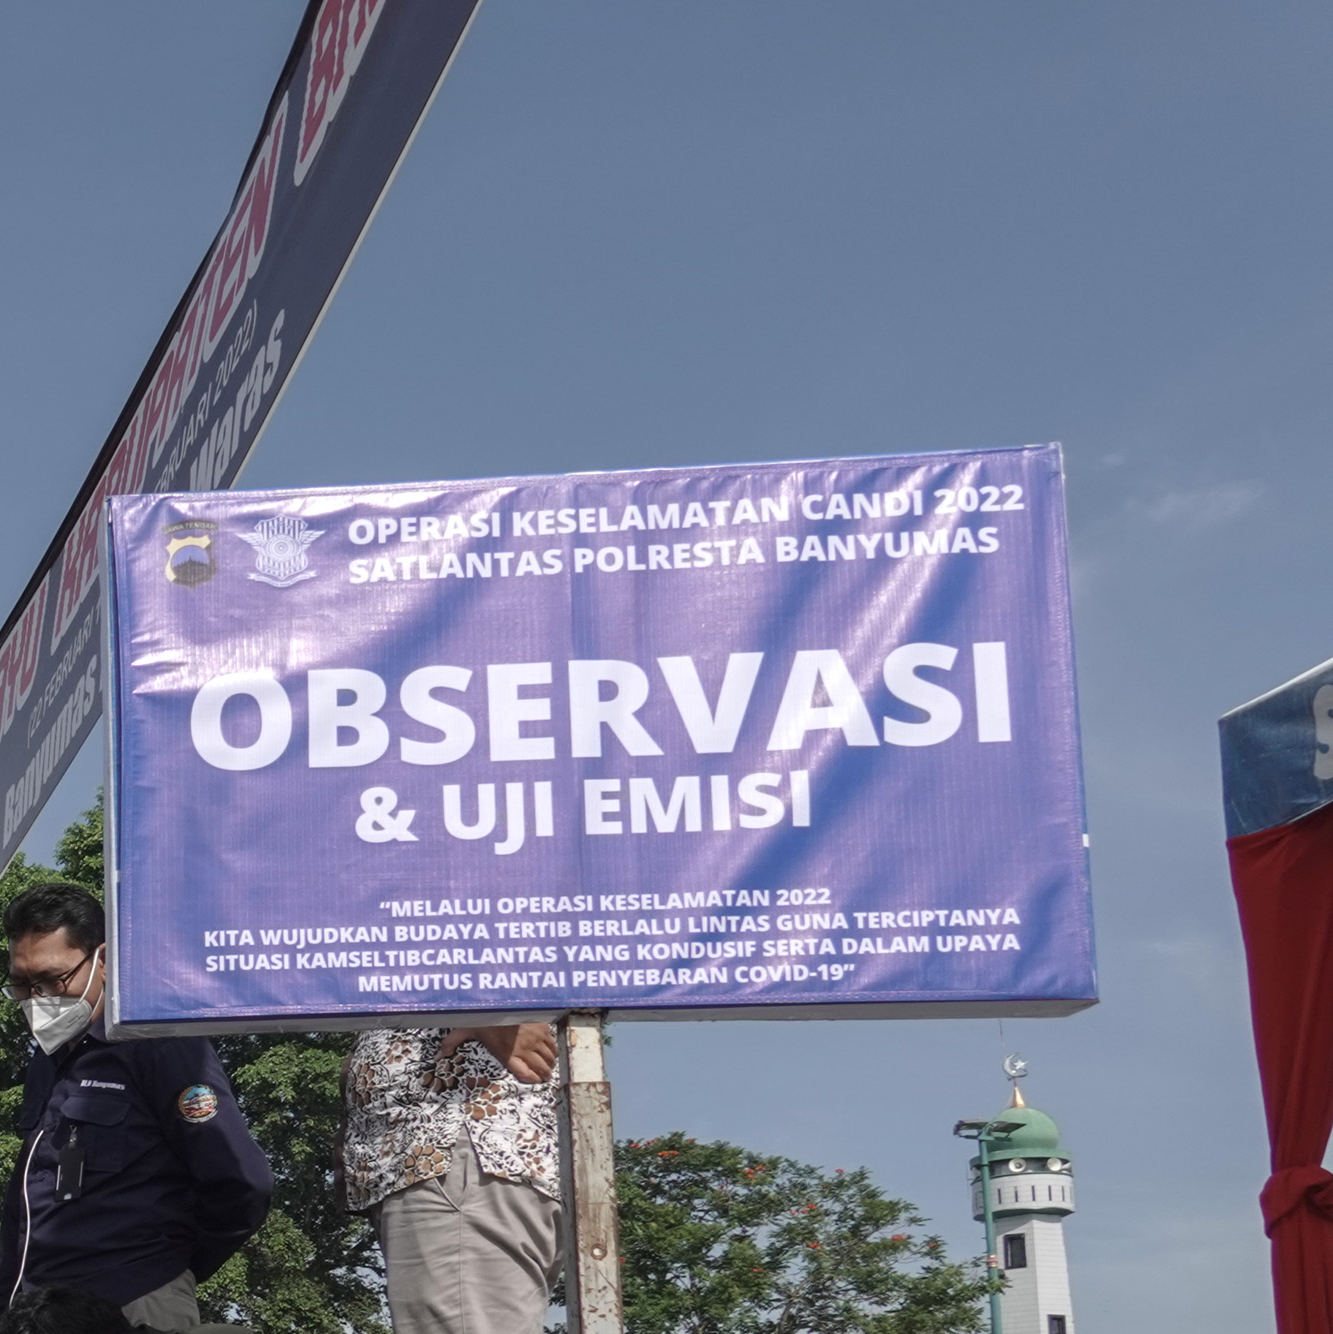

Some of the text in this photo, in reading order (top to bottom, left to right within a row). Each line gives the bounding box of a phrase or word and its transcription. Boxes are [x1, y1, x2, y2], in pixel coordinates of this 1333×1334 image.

[348, 484, 1025, 545] OPERASI KESELAMATAN CANDI 2022
[349, 549, 563, 585] SATLANTAS
[573, 538, 766, 574] POLRESTA
[776, 526, 1000, 563] BANYUMAS
[42, 614, 93, 709] FEBRUARI
[190, 640, 1012, 771] OBSERVASI
[2, 653, 98, 850] Banyumas
[353, 769, 811, 856] & UJI EMISI
[204, 907, 1021, 950] KITA WUJUDKAN BUDAYA TERTIB BERLALU LINTAS GUNA TERCIPTANYA
[497, 895, 593, 915] OPERASI
[600, 889, 770, 912] KESELAMATAN
[776, 887, 832, 906] 2022
[205, 932, 1021, 972] SITUASI KAMSELTIBCARLANTAS YANG KONDUSIF SERTA DALAM UPAYA
[358, 973, 473, 993] MEMUTUS
[478, 970, 565, 990] RANTAI
[572, 966, 728, 988] PENYEBARAN
